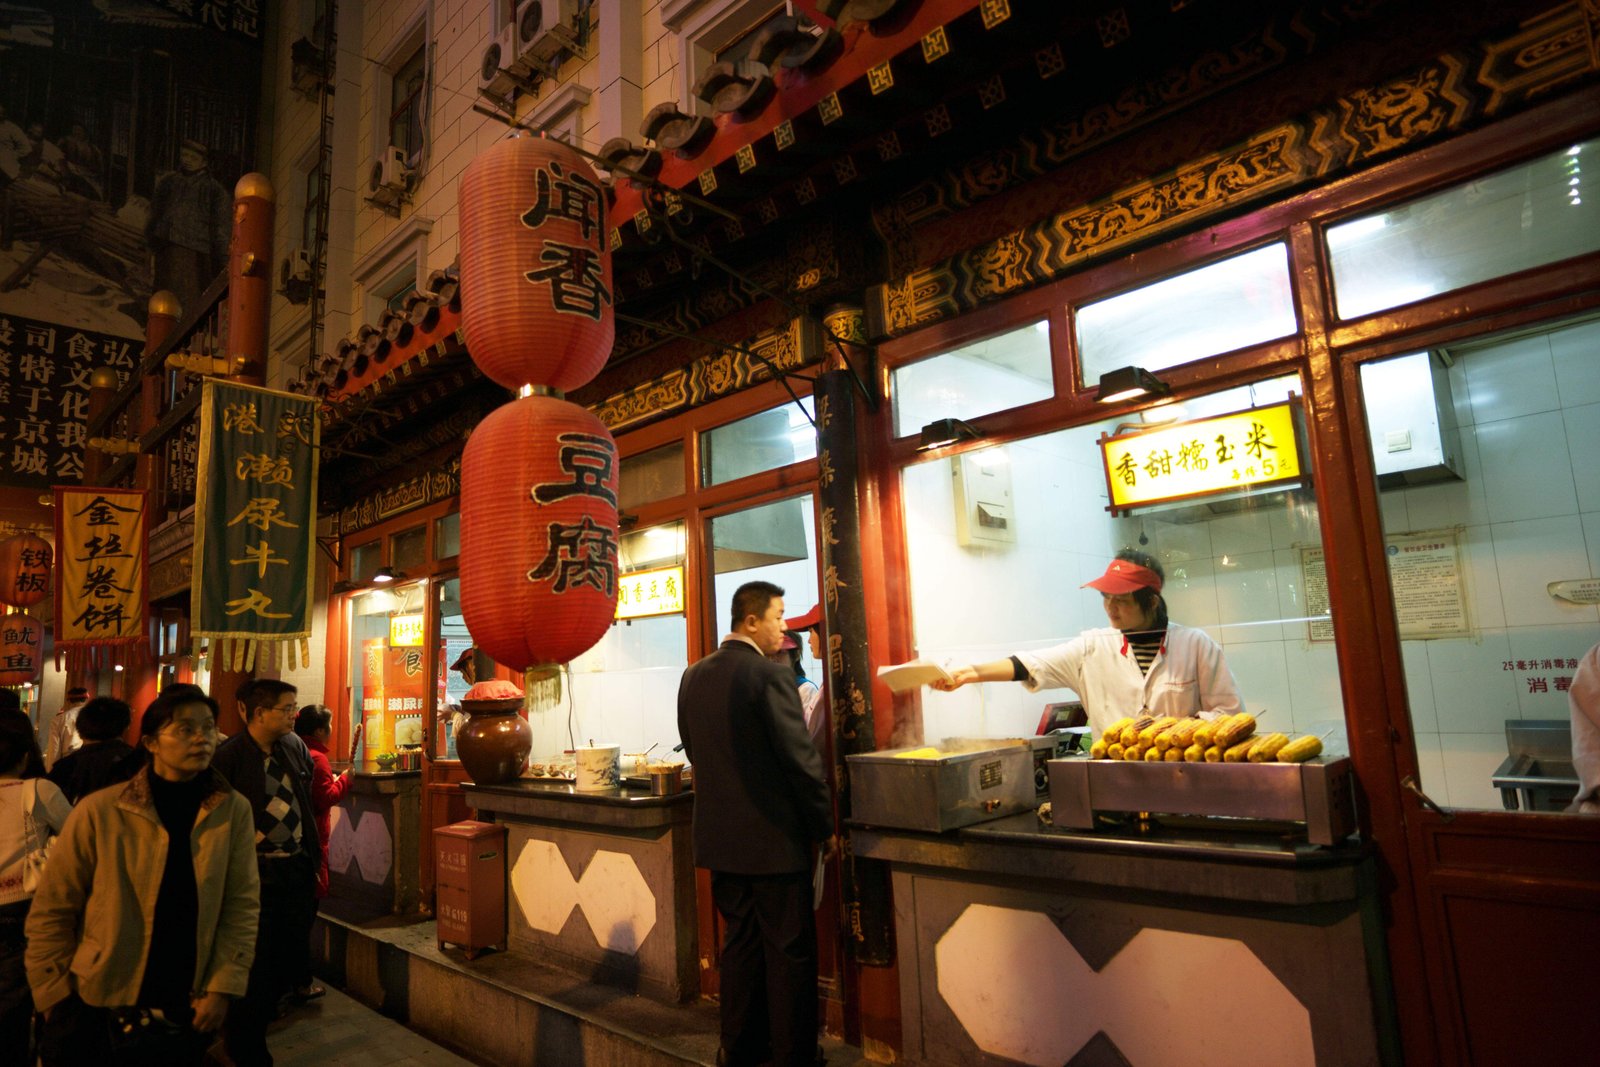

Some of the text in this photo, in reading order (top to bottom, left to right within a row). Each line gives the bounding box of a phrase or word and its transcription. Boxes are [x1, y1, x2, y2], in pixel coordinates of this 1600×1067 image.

[520, 160, 612, 322] 闻香
[11, 323, 56, 477] 司特于京城
[55, 331, 96, 481] 食文化我公
[1115, 422, 1278, 488] 香甜糯玉米
[16, 547, 50, 593] 铁板
[73, 496, 140, 636] 金丝卷饼
[527, 431, 617, 598] 豆腐
[1, 626, 37, 674] 鱿鱼
